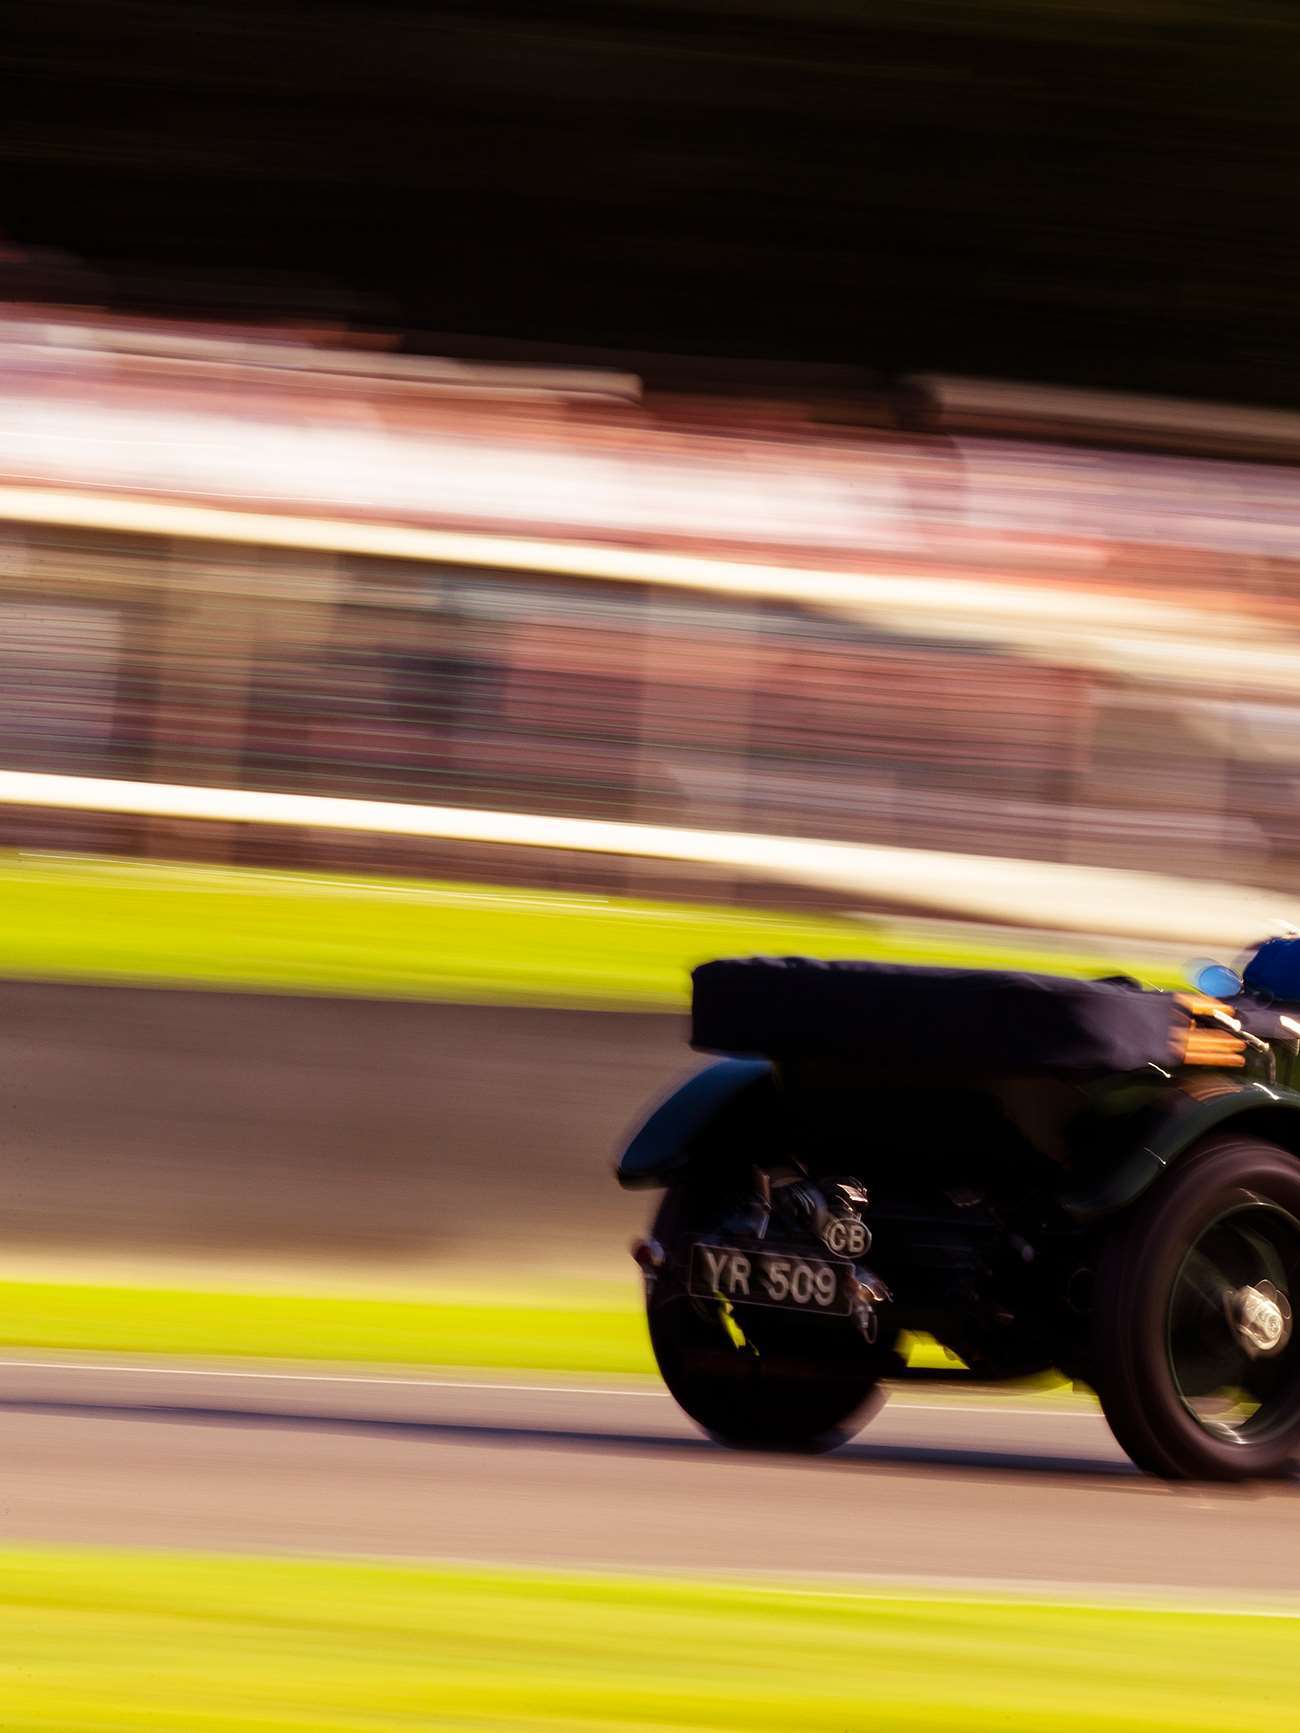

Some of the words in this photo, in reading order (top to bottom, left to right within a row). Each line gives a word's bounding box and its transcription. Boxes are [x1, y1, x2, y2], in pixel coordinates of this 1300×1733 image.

[828, 1222, 867, 1252] GB
[704, 1250, 750, 1296] YR
[763, 1259, 837, 1307] 509
